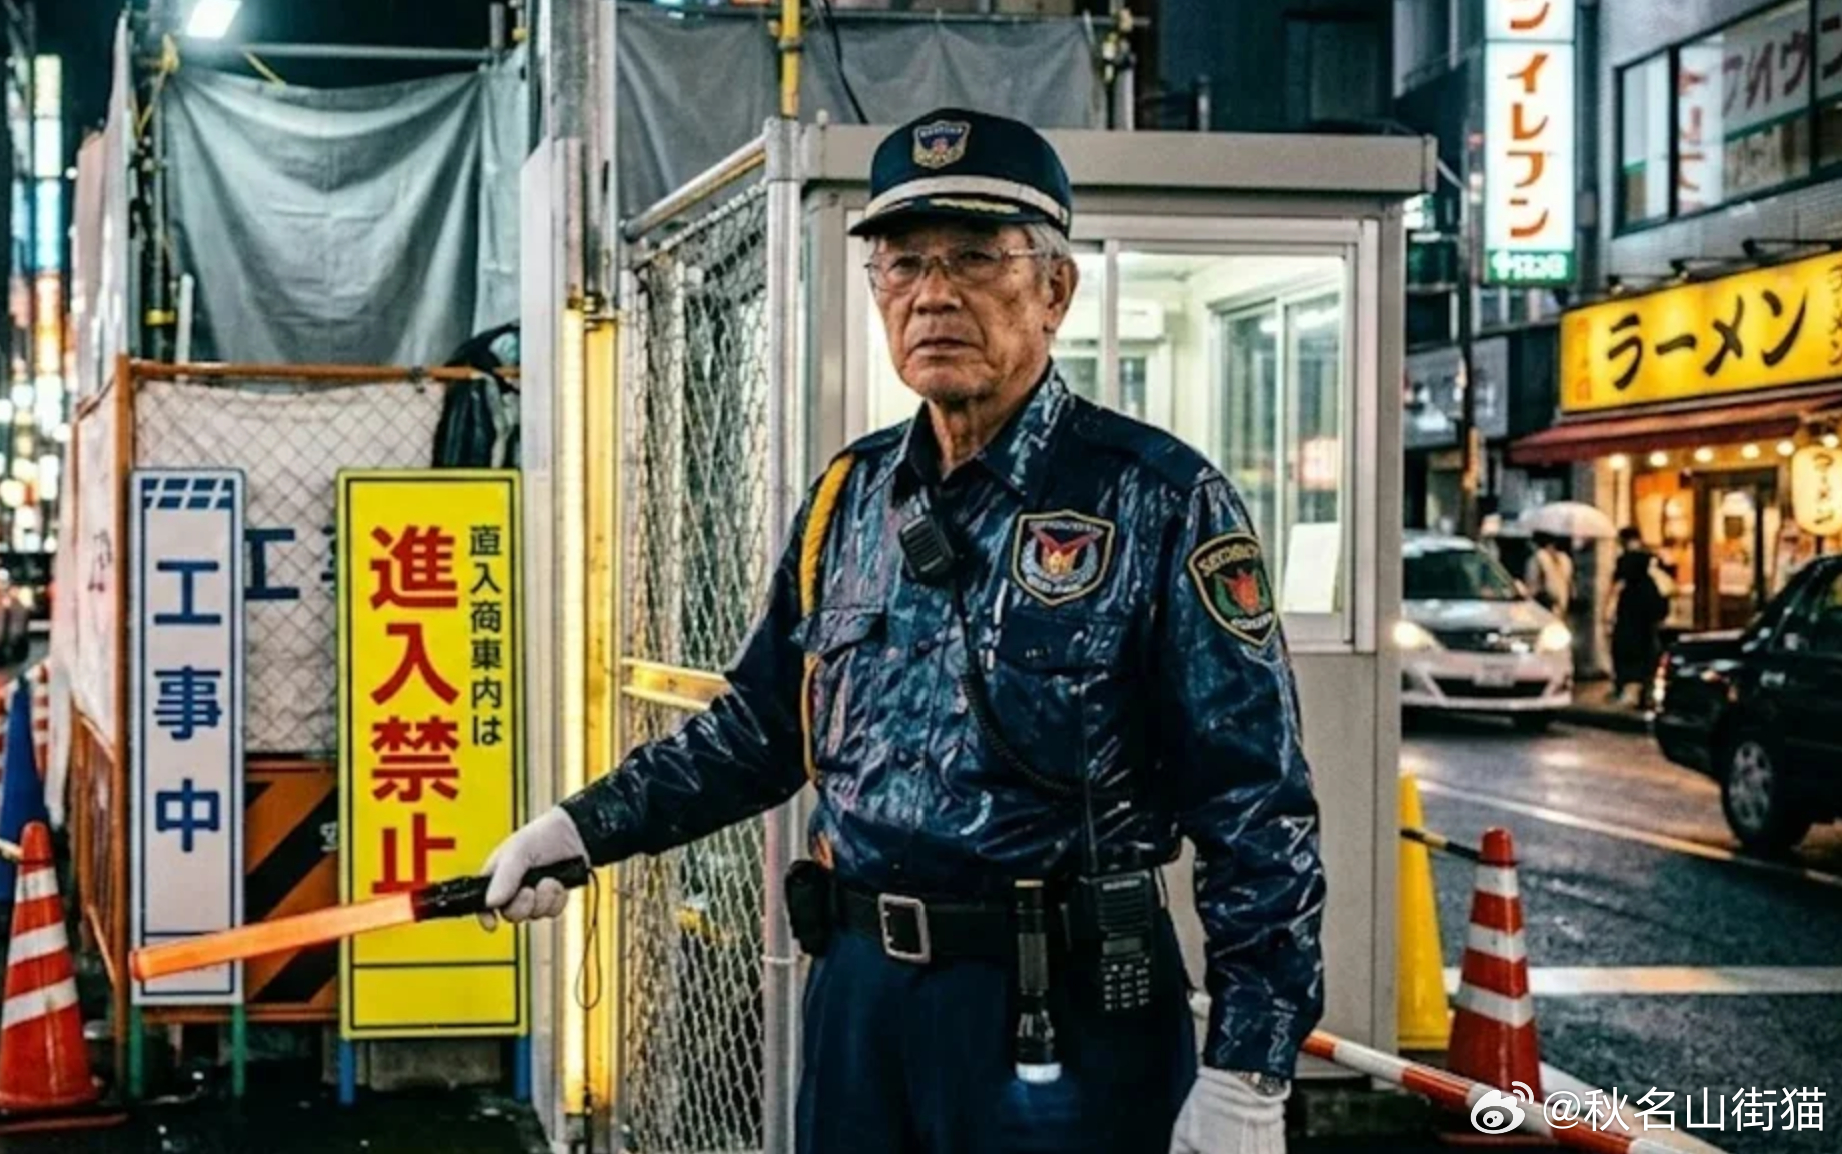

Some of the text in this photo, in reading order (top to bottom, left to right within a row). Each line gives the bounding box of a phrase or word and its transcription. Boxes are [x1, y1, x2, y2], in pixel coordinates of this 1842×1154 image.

[1607, 286, 1808, 391] ラーメン
[153, 559, 223, 853] 工事中
[369, 524, 461, 894] 進入禁止
